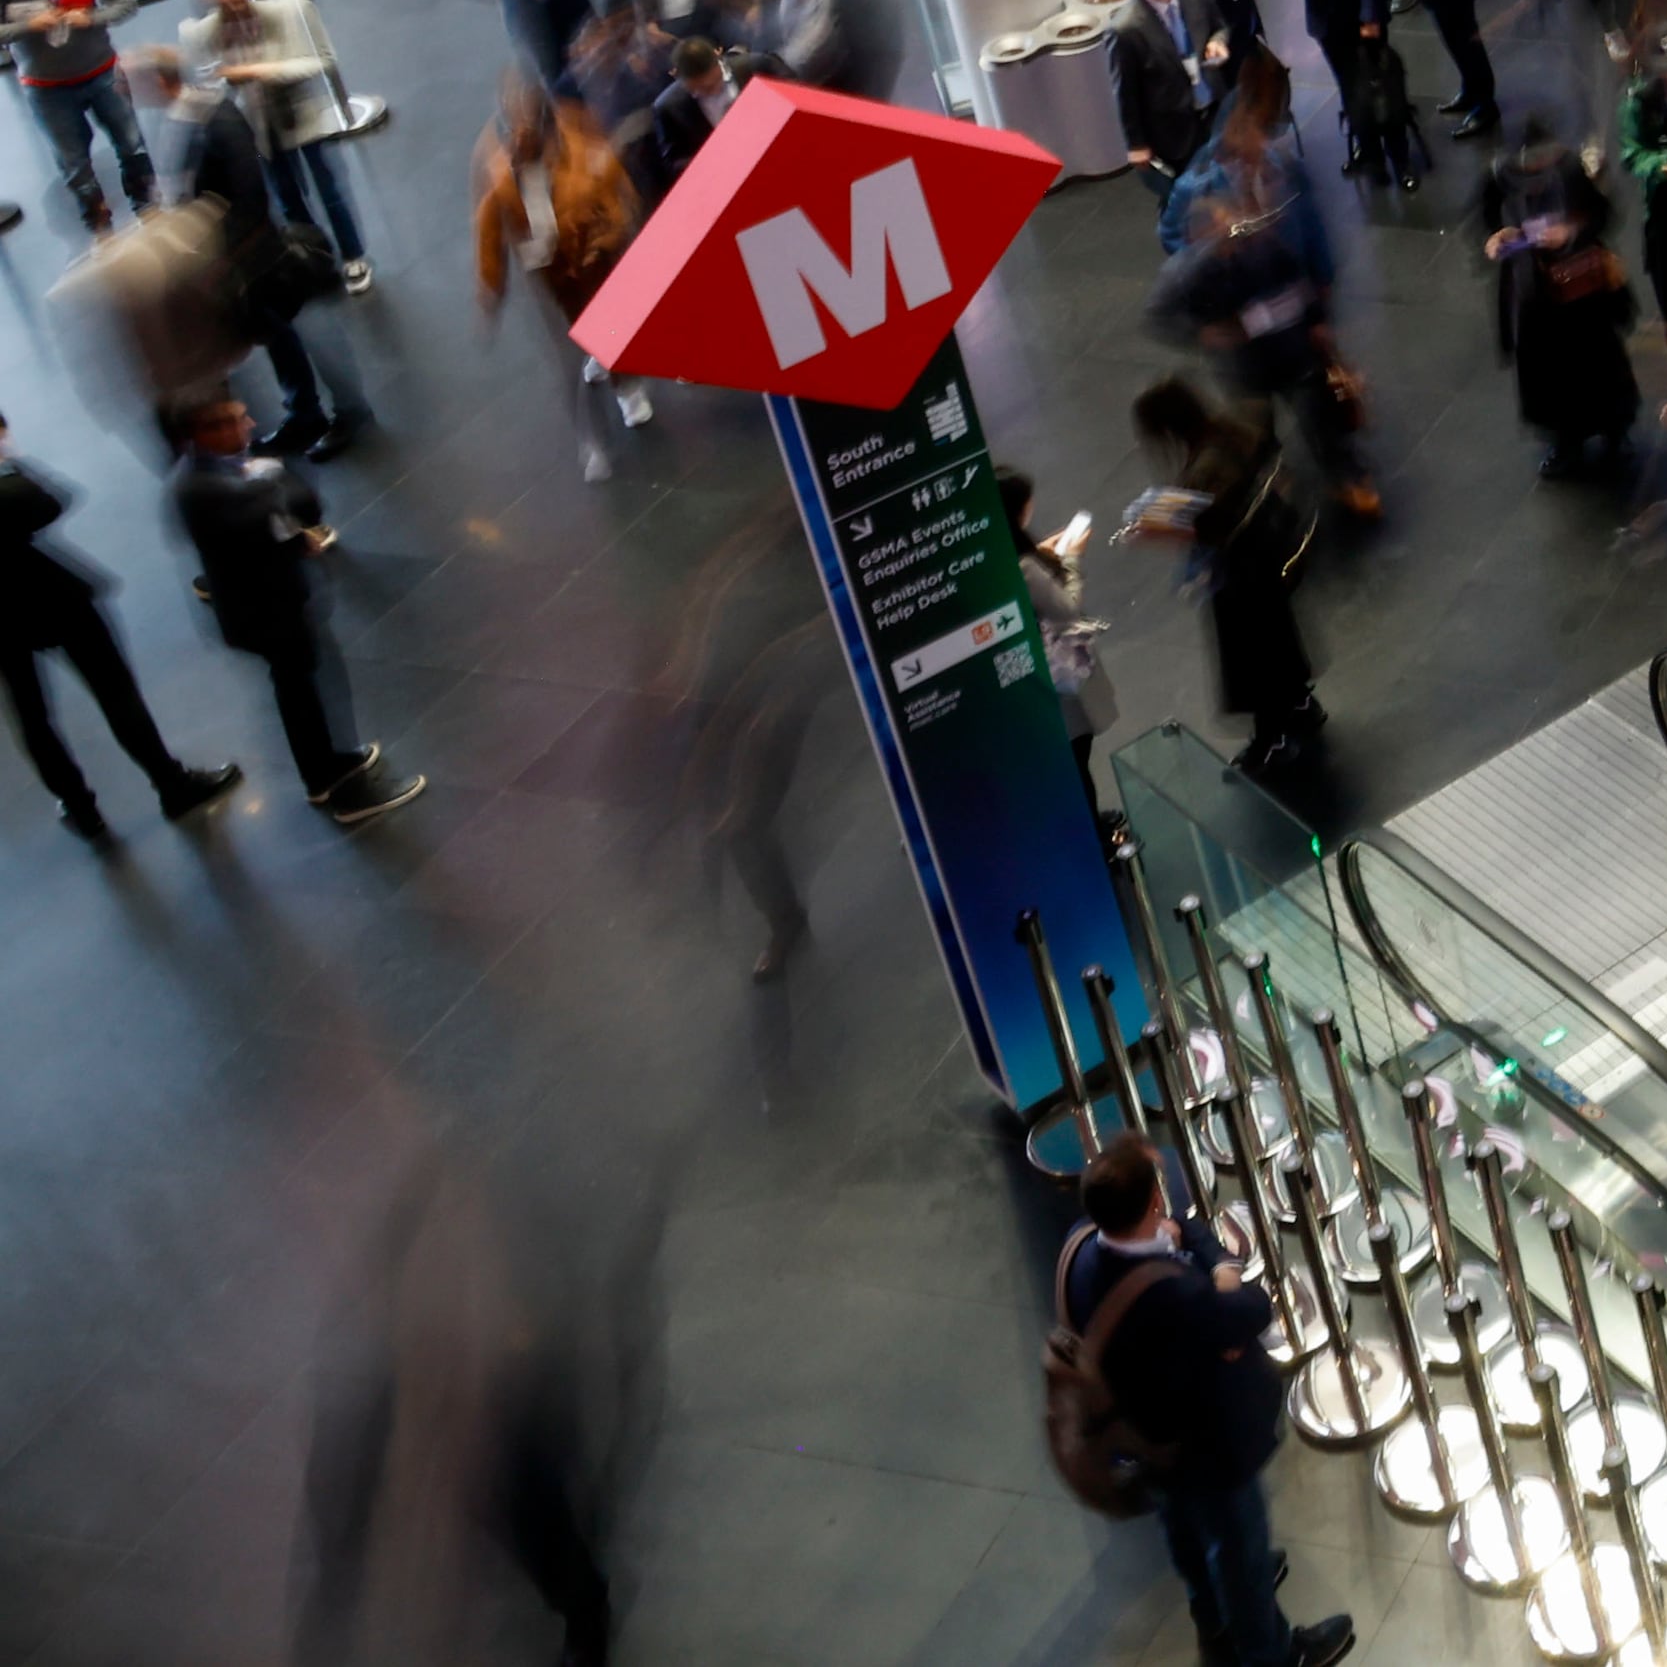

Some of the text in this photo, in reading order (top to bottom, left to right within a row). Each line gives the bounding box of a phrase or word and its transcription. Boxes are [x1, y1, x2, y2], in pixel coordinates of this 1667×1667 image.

[735, 157, 953, 371] M
[827, 433, 884, 470] South
[832, 441, 916, 489] Entrance
[858, 510, 966, 569] GSMA Events
[863, 516, 990, 586] Enquiries Office
[872, 550, 985, 614] Exhibitor Care
[876, 582, 958, 631] Help Desk
